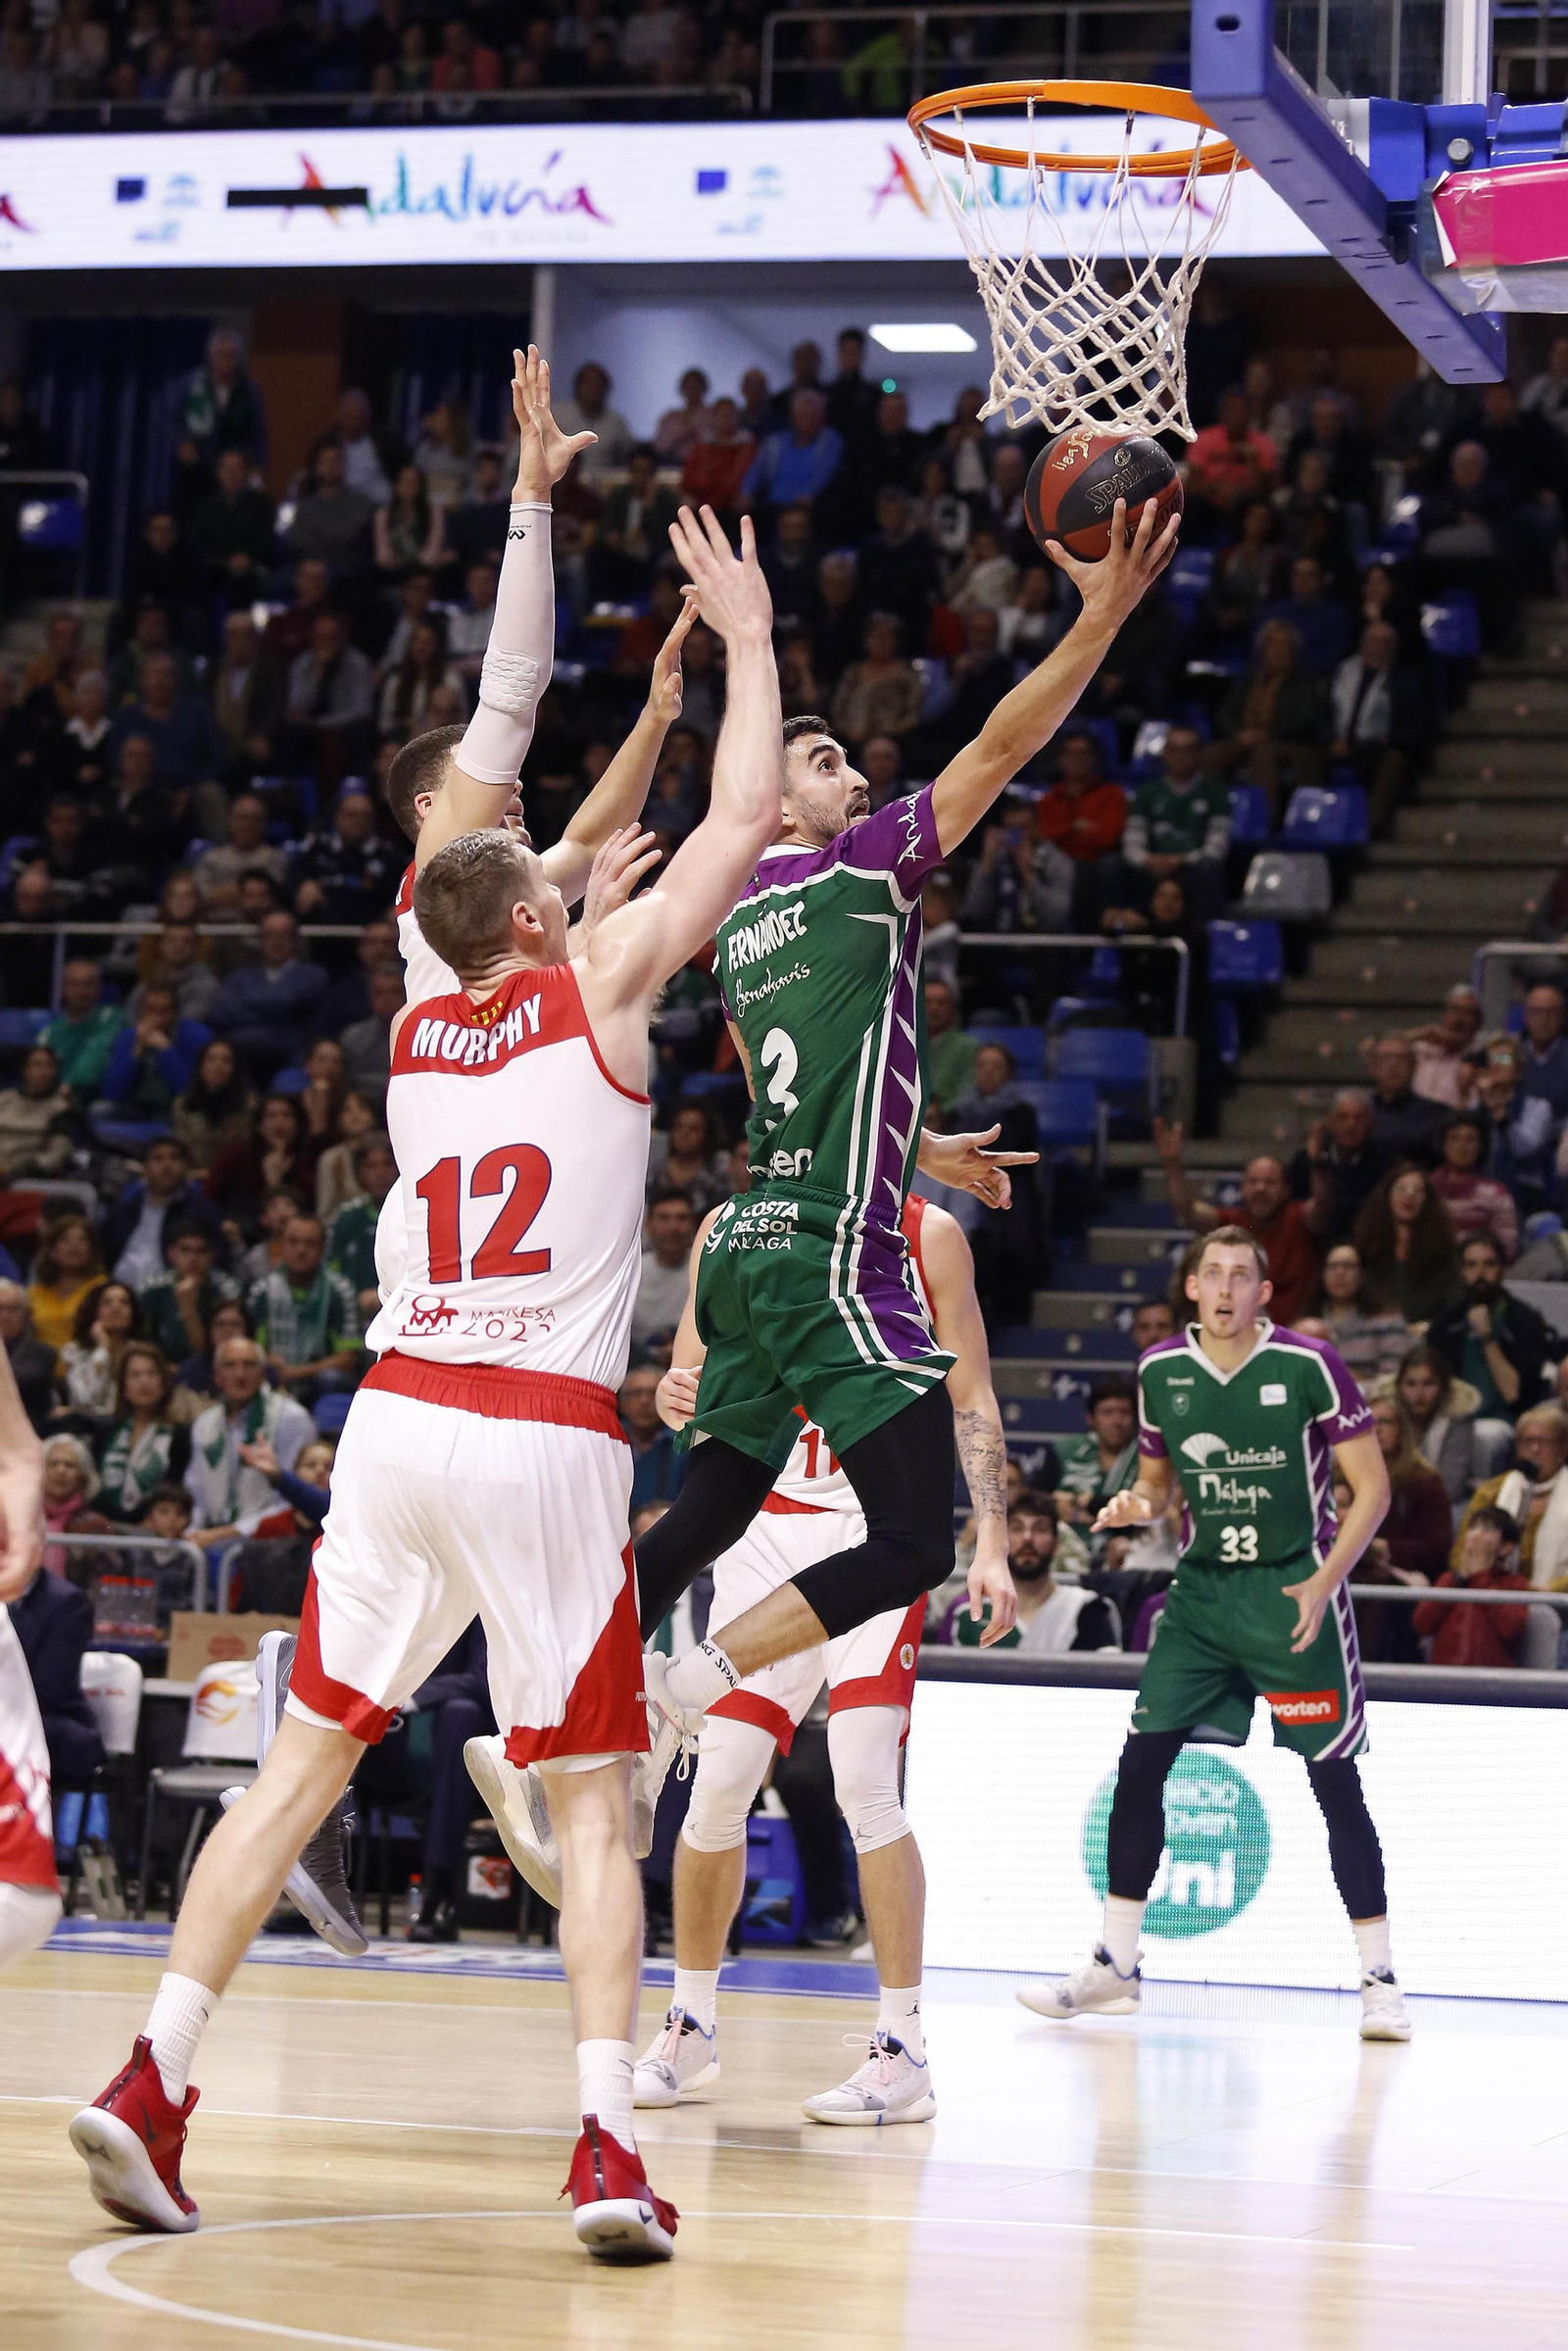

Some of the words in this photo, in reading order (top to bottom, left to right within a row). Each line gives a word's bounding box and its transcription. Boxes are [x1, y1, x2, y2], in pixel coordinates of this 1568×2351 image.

[411, 992, 542, 1066] MURPHY
[416, 1143, 553, 1285] 12
[741, 1200, 800, 1221] COSTA
[731, 1218, 756, 1235] DEL
[756, 1217, 798, 1234] SOL
[1226, 1445, 1287, 1466] Unicaja
[1219, 1524, 1259, 1563] 33
